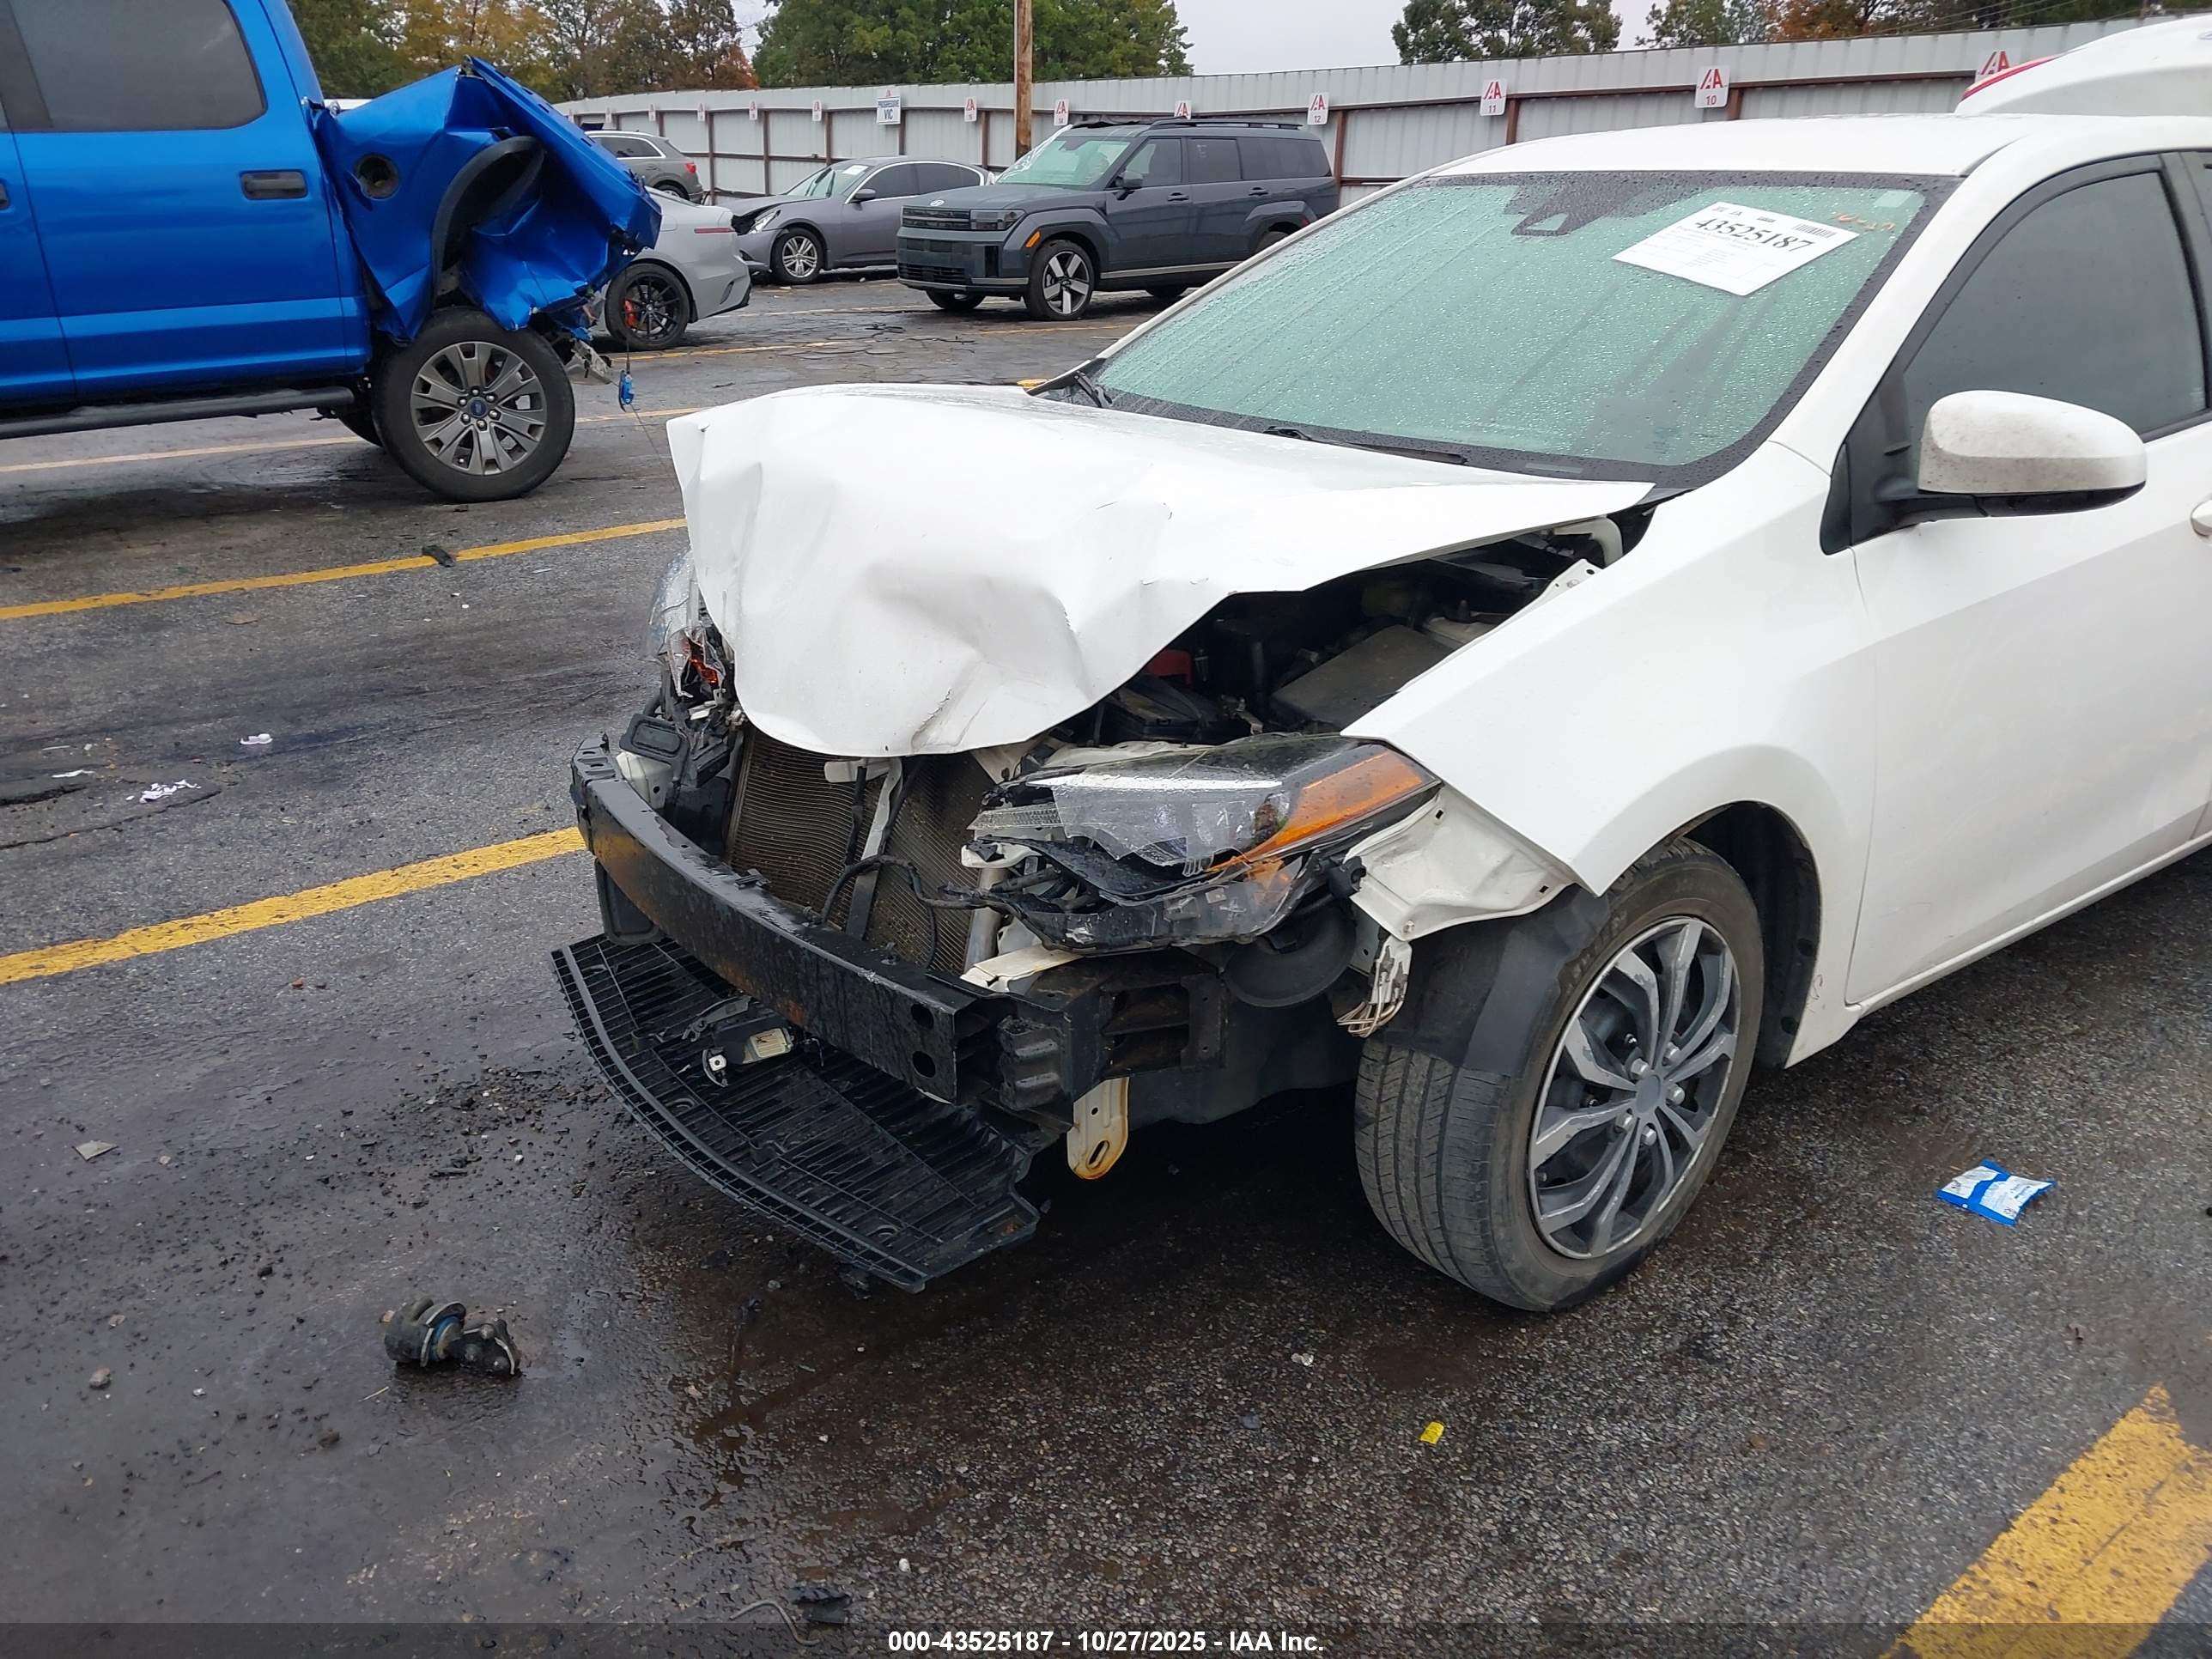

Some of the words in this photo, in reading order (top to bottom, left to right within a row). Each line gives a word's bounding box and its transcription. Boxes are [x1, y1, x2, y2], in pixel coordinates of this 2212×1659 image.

[1705, 94, 1717, 105] 10
[1488, 105, 1497, 113] 11
[1694, 218, 1814, 252] 43525187
